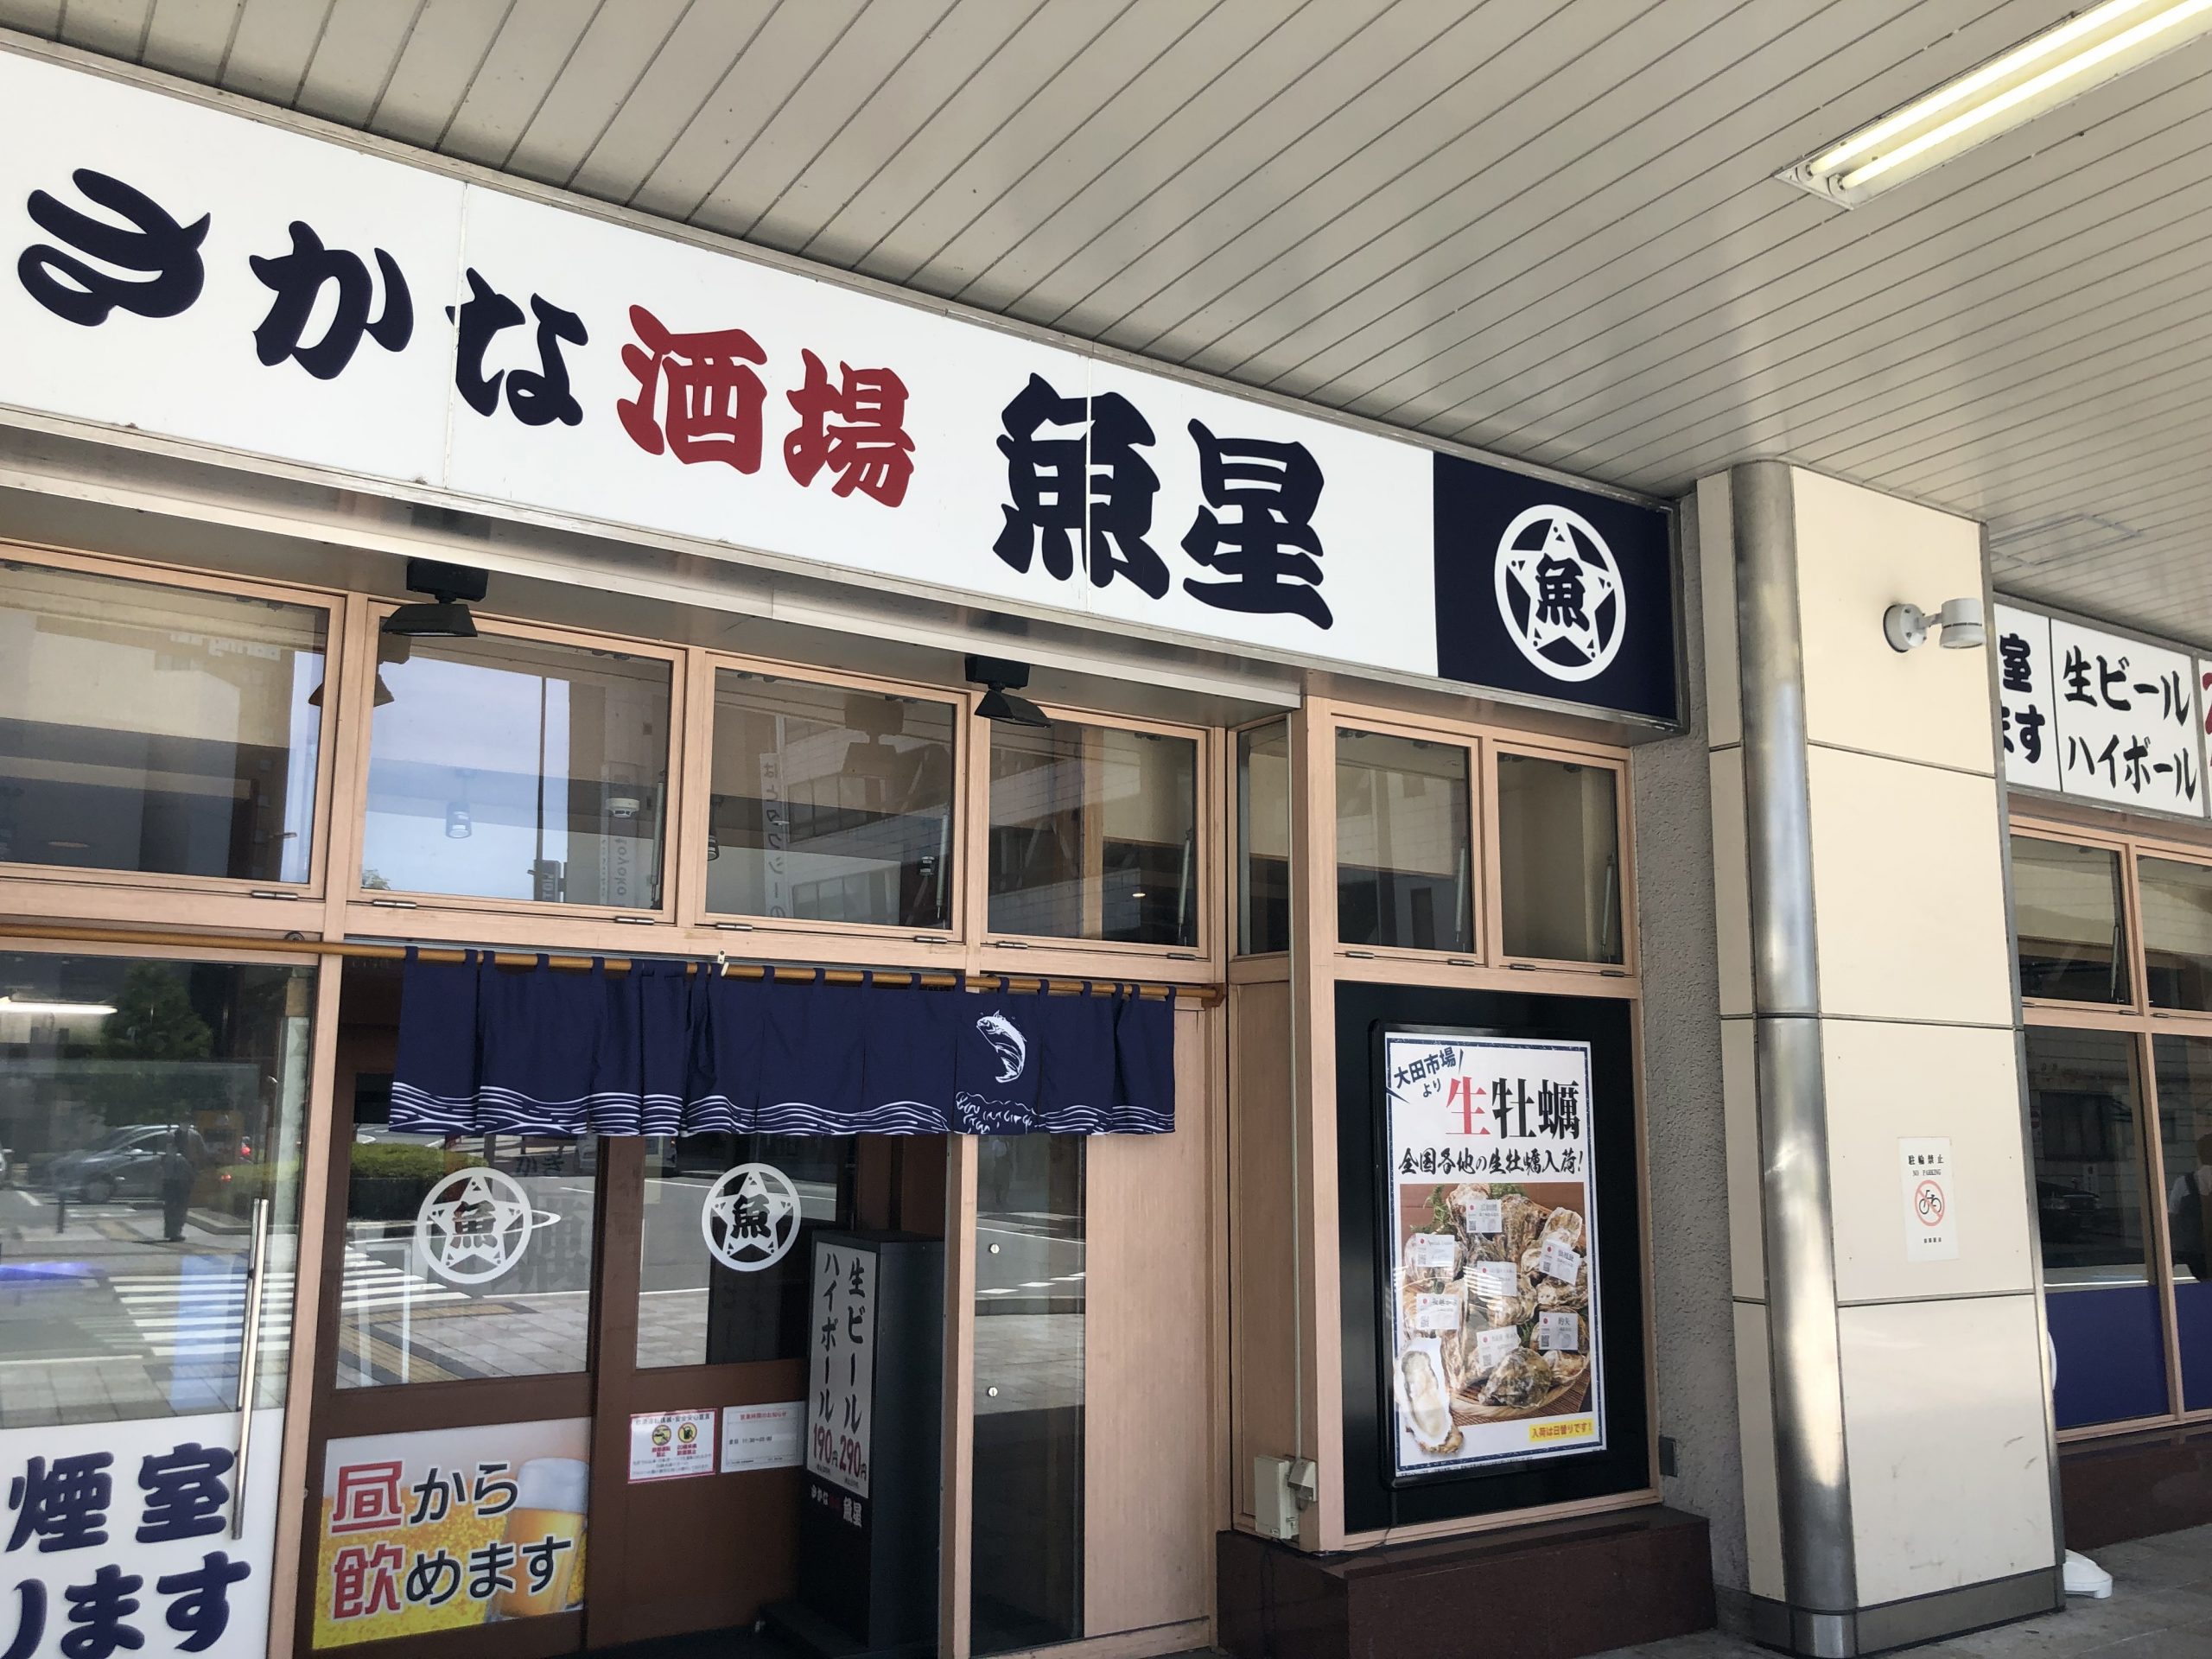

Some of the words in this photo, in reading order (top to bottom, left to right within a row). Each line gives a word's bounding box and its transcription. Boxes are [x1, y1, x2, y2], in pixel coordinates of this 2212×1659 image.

[17, 168, 916, 508] さかな酒場
[992, 372, 1334, 631] 魚星
[1535, 552, 1591, 632] 魚
[2063, 645, 2191, 727] 生ビール
[2068, 734, 2197, 802] ハイボール
[1393, 1046, 1457, 1090] 大田市場
[1422, 1077, 1442, 1098] より
[1445, 1076, 1580, 1141] 生牡蠣
[449, 1199, 499, 1249] 魚
[730, 1193, 772, 1240] 魚
[844, 1256, 866, 1435] 生ビール
[5, 1442, 234, 1553] 煙室
[332, 1460, 518, 1533] 昼から
[333, 1535, 572, 1620] 飲めます
